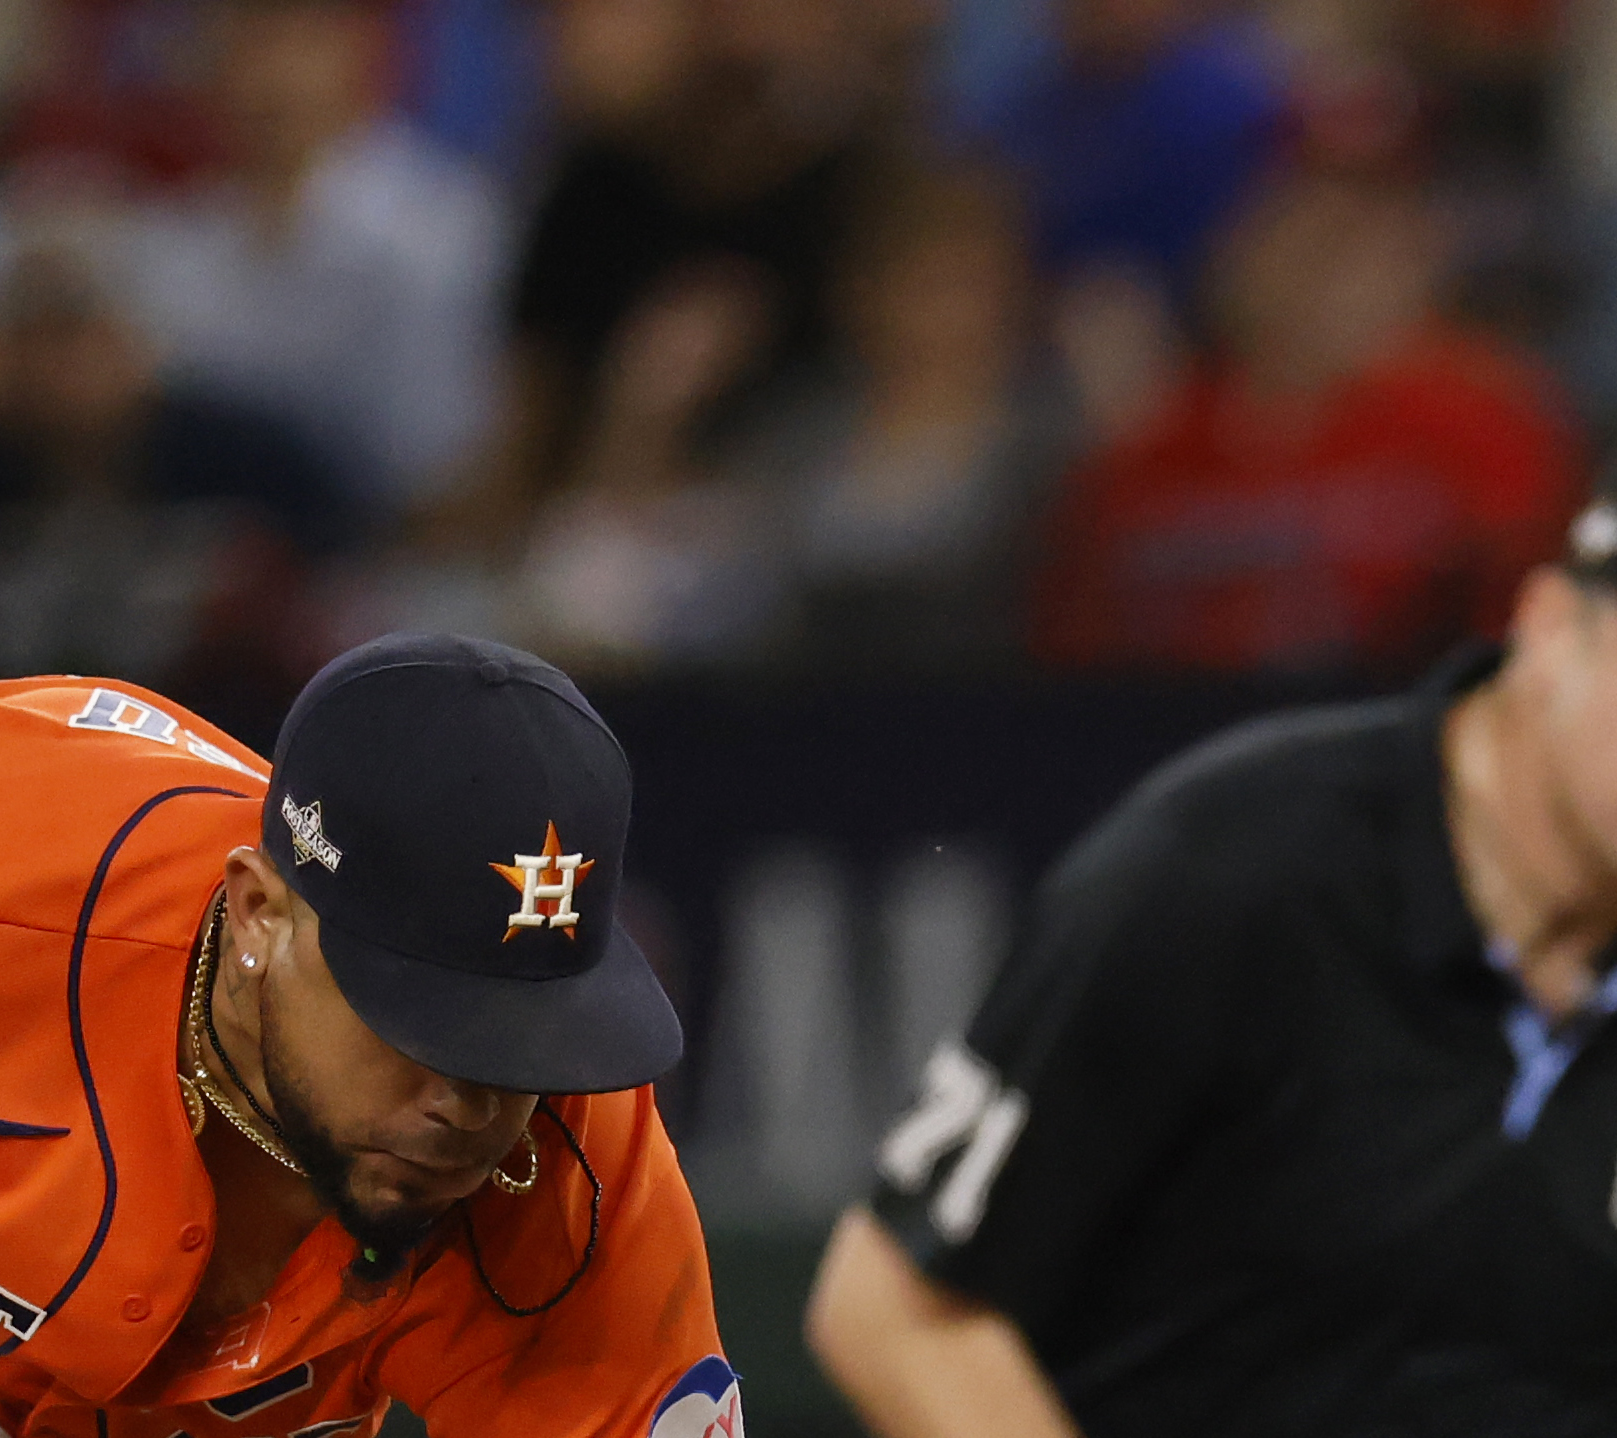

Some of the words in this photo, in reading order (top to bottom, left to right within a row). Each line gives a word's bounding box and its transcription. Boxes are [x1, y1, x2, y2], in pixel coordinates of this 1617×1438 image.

[282, 796, 342, 870] POSTSEASON
[507, 852, 584, 929] H
[877, 1044, 1031, 1243] 71
